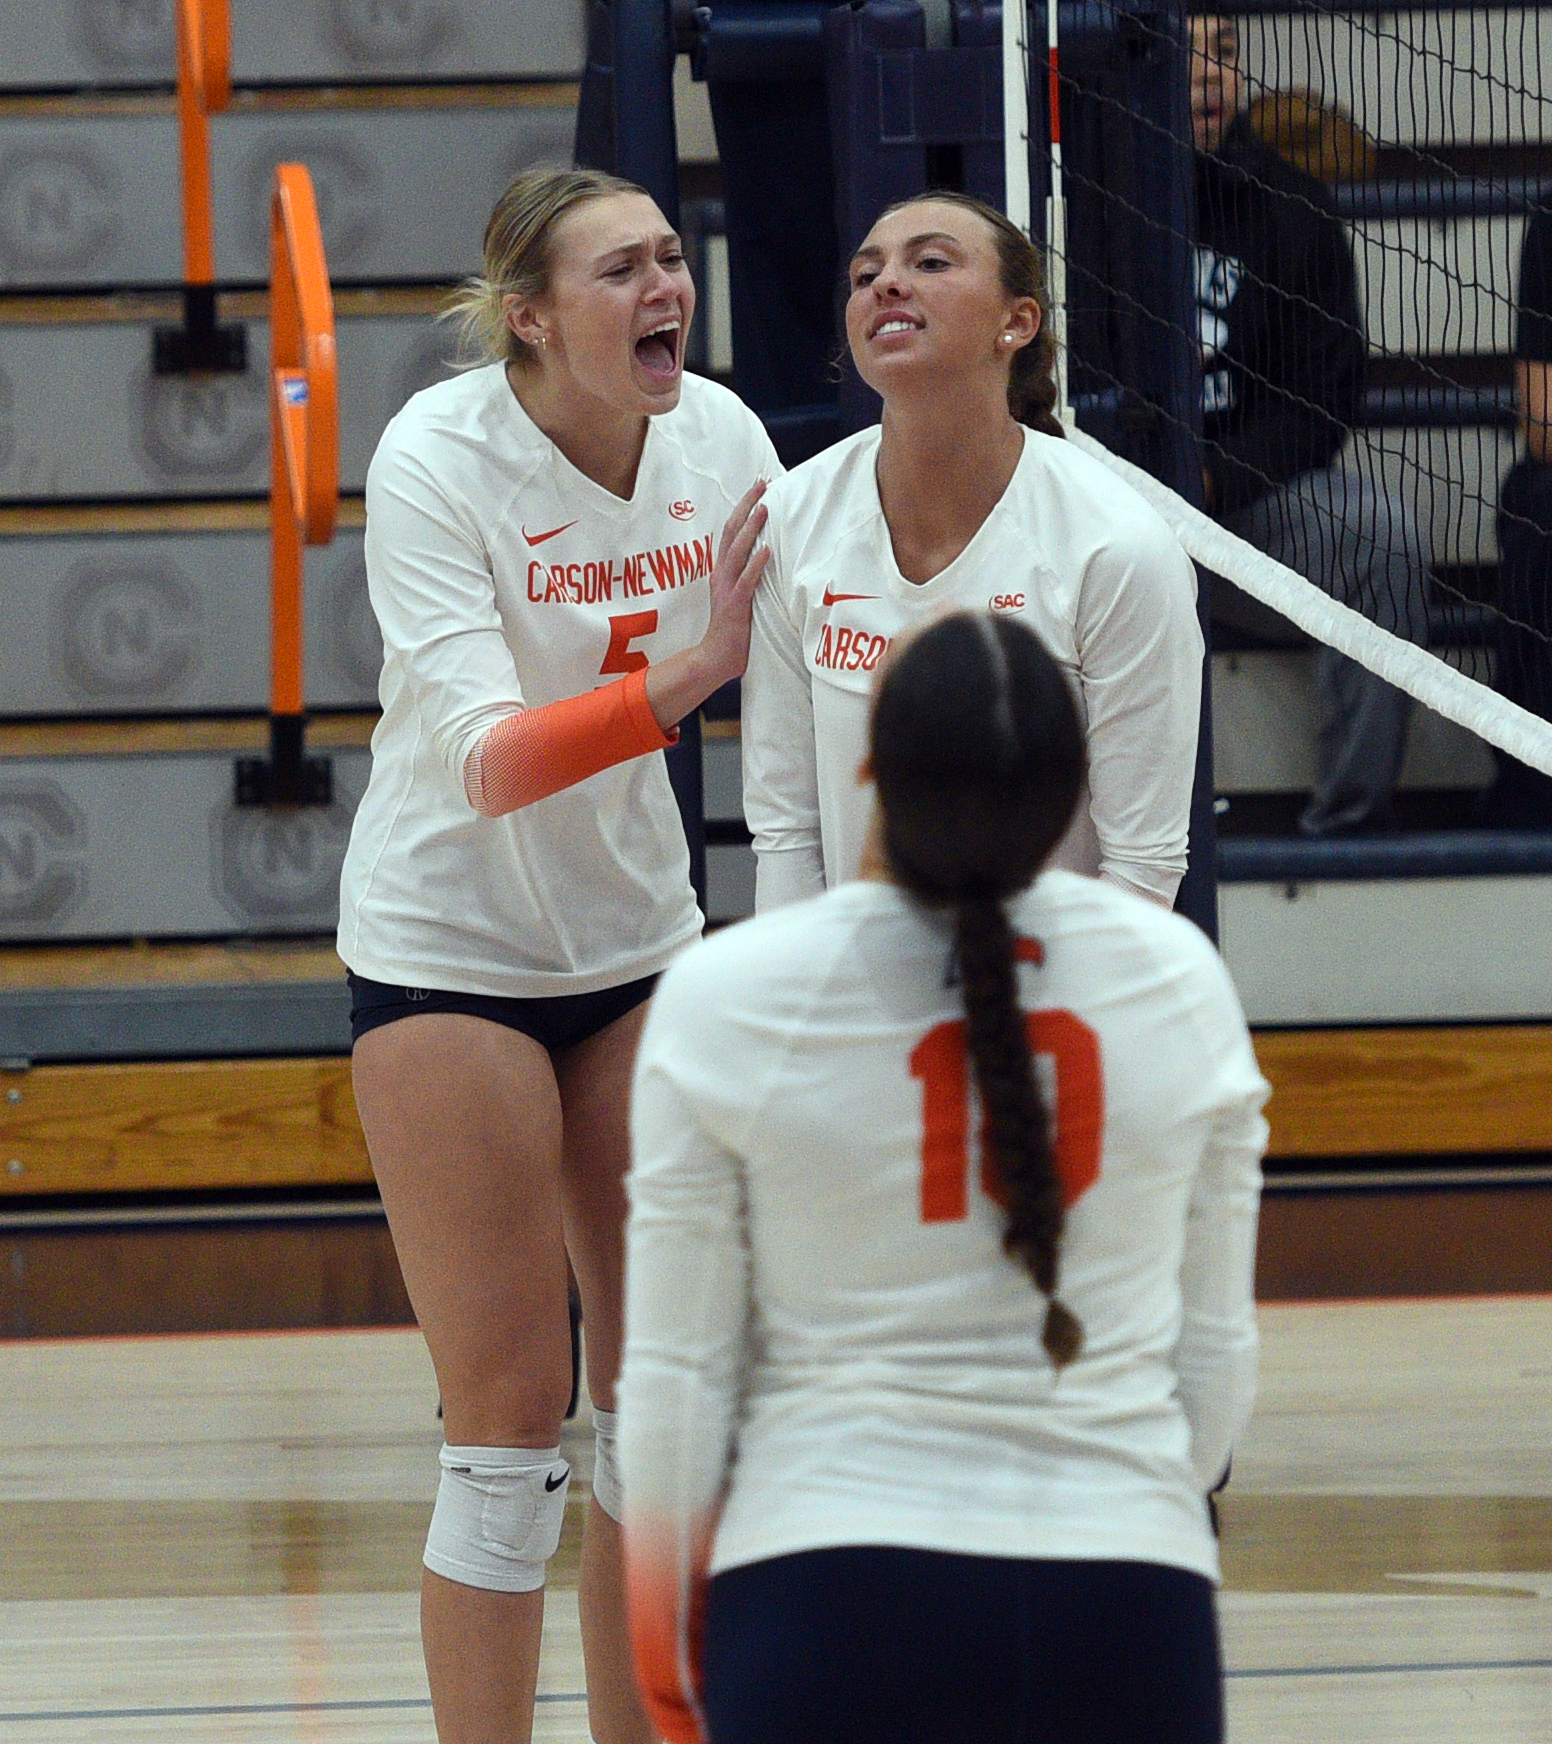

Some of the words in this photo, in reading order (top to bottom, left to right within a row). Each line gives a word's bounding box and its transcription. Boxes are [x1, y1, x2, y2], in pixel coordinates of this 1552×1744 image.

[527, 532, 714, 605] CARSON-NEWMAN
[993, 592, 1027, 610] SAC
[598, 608, 659, 675] 5
[814, 622, 896, 671] CARSO
[908, 1007, 1106, 1224] 10
